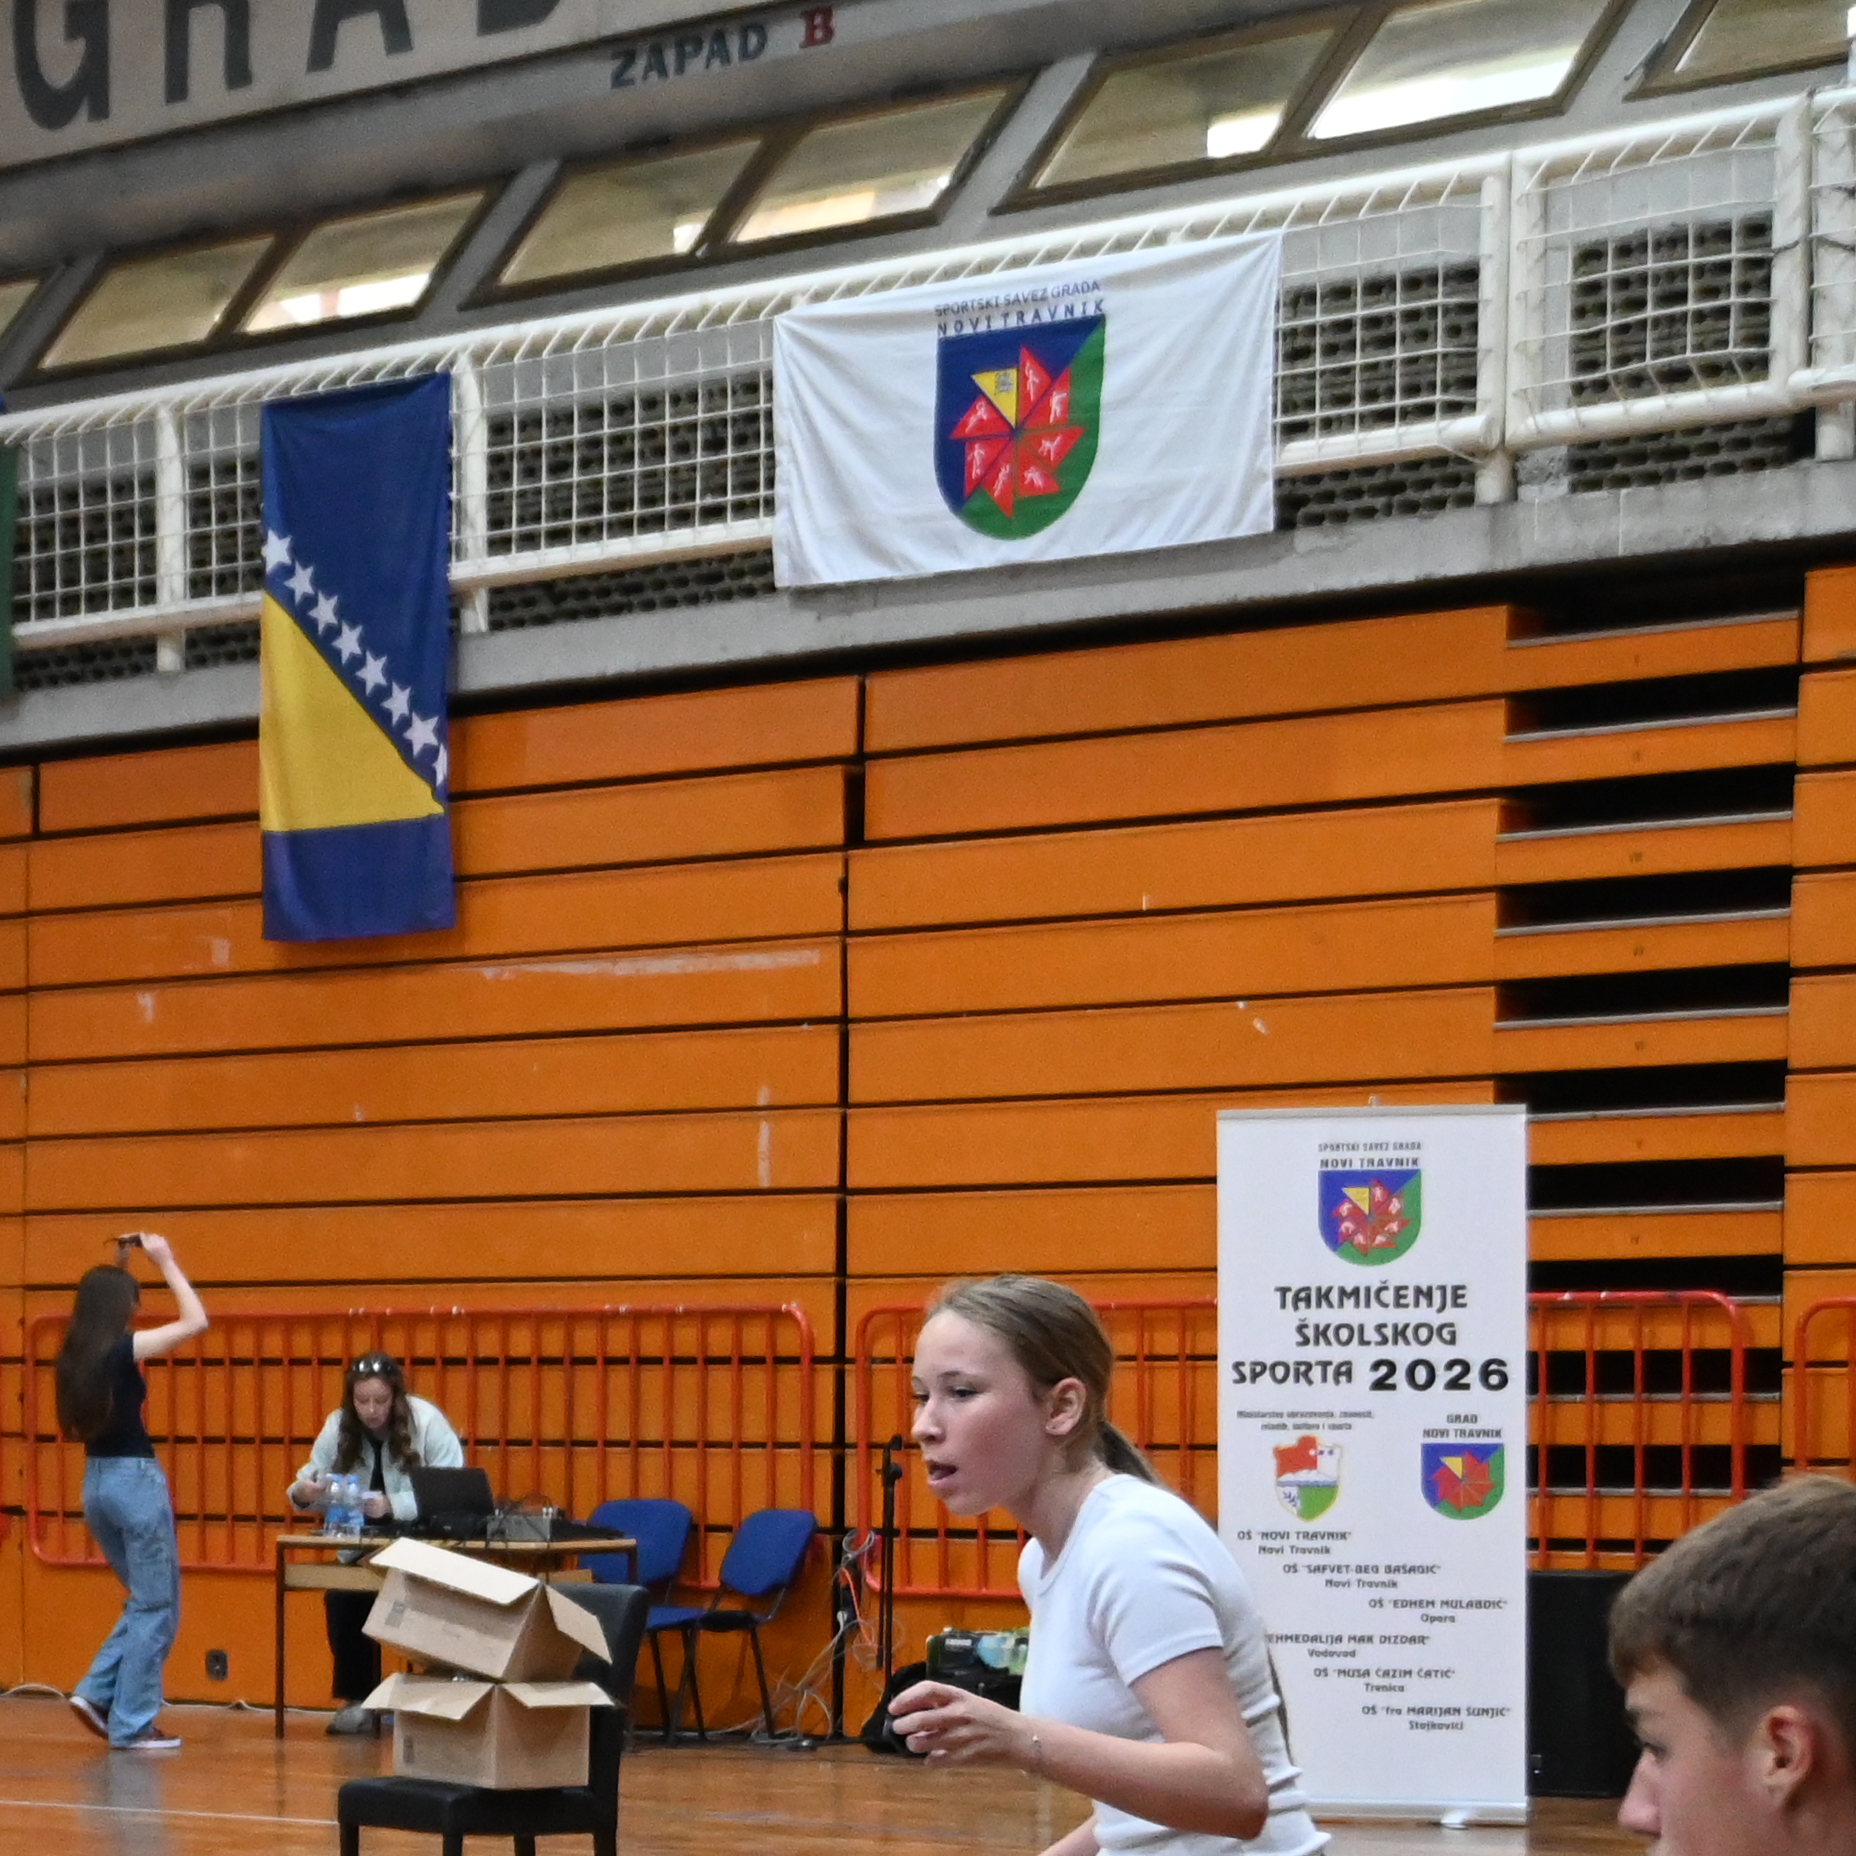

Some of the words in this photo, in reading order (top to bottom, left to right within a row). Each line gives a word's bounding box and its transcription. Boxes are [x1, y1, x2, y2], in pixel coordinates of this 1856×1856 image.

[609, 23, 769, 89] ZAPAD
[797, 5, 835, 49] B
[935, 295, 999, 317] SPORTSKI
[1004, 288, 1048, 306] SAVEZ
[1051, 280, 1101, 299] GRADA
[938, 316, 992, 336] NOVI
[1001, 299, 1105, 324] TRAVNIK
[1320, 1158, 1353, 1168] NOVI
[1359, 1157, 1419, 1168] TRAVNIK
[1274, 1279, 1468, 1314] TAKMIČENJE
[1295, 1317, 1457, 1347] ŠKOLSKOG
[1231, 1359, 1353, 1387] SPORTA
[1368, 1358, 1509, 1392] 2026
[1446, 1413, 1478, 1424] GRAD
[1422, 1428, 1450, 1438] NOVI
[1454, 1428, 1502, 1439] TRAVNIK
[1237, 1529, 1252, 1541] OŠ
[1258, 1545, 1285, 1555] Novi
[1289, 1545, 1331, 1555] Travnik
[1282, 1563, 1298, 1574] OŠ
[1325, 1578, 1351, 1588] Novi
[1356, 1578, 1398, 1588] Travnik
[1368, 1597, 1384, 1609] OŠ
[1313, 1667, 1329, 1678] OŠ
[1361, 1705, 1377, 1715] OŠ
